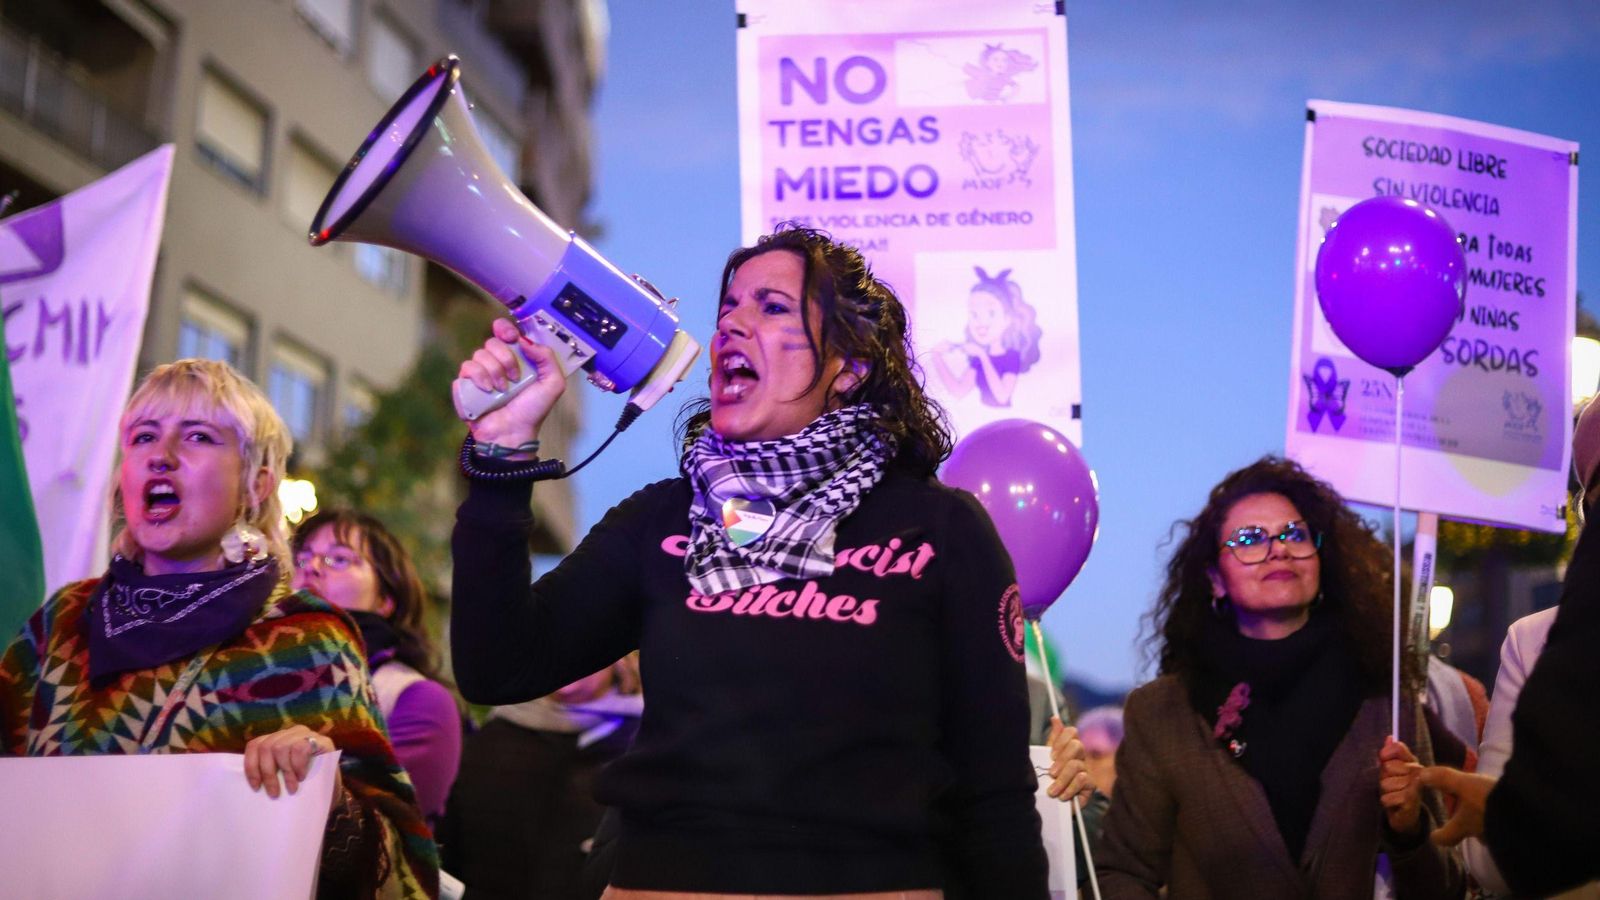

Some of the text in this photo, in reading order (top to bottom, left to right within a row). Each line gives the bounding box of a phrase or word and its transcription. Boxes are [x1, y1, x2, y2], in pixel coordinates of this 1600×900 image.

[779, 56, 887, 106] NO
[768, 116, 939, 147] TENGAS
[1362, 136, 1507, 179] SOCIEDAD LIBRE
[774, 164, 939, 201] MIEDO
[1410, 183, 1500, 216] VIOLENCIA
[818, 213, 920, 229] VIOLENCIA
[926, 212, 950, 227] DE
[957, 208, 1033, 226] GÉNERO
[1488, 232, 1532, 263] TODAS
[1469, 267, 1546, 298] MUJERES
[1440, 336, 1539, 379] SORDAS
